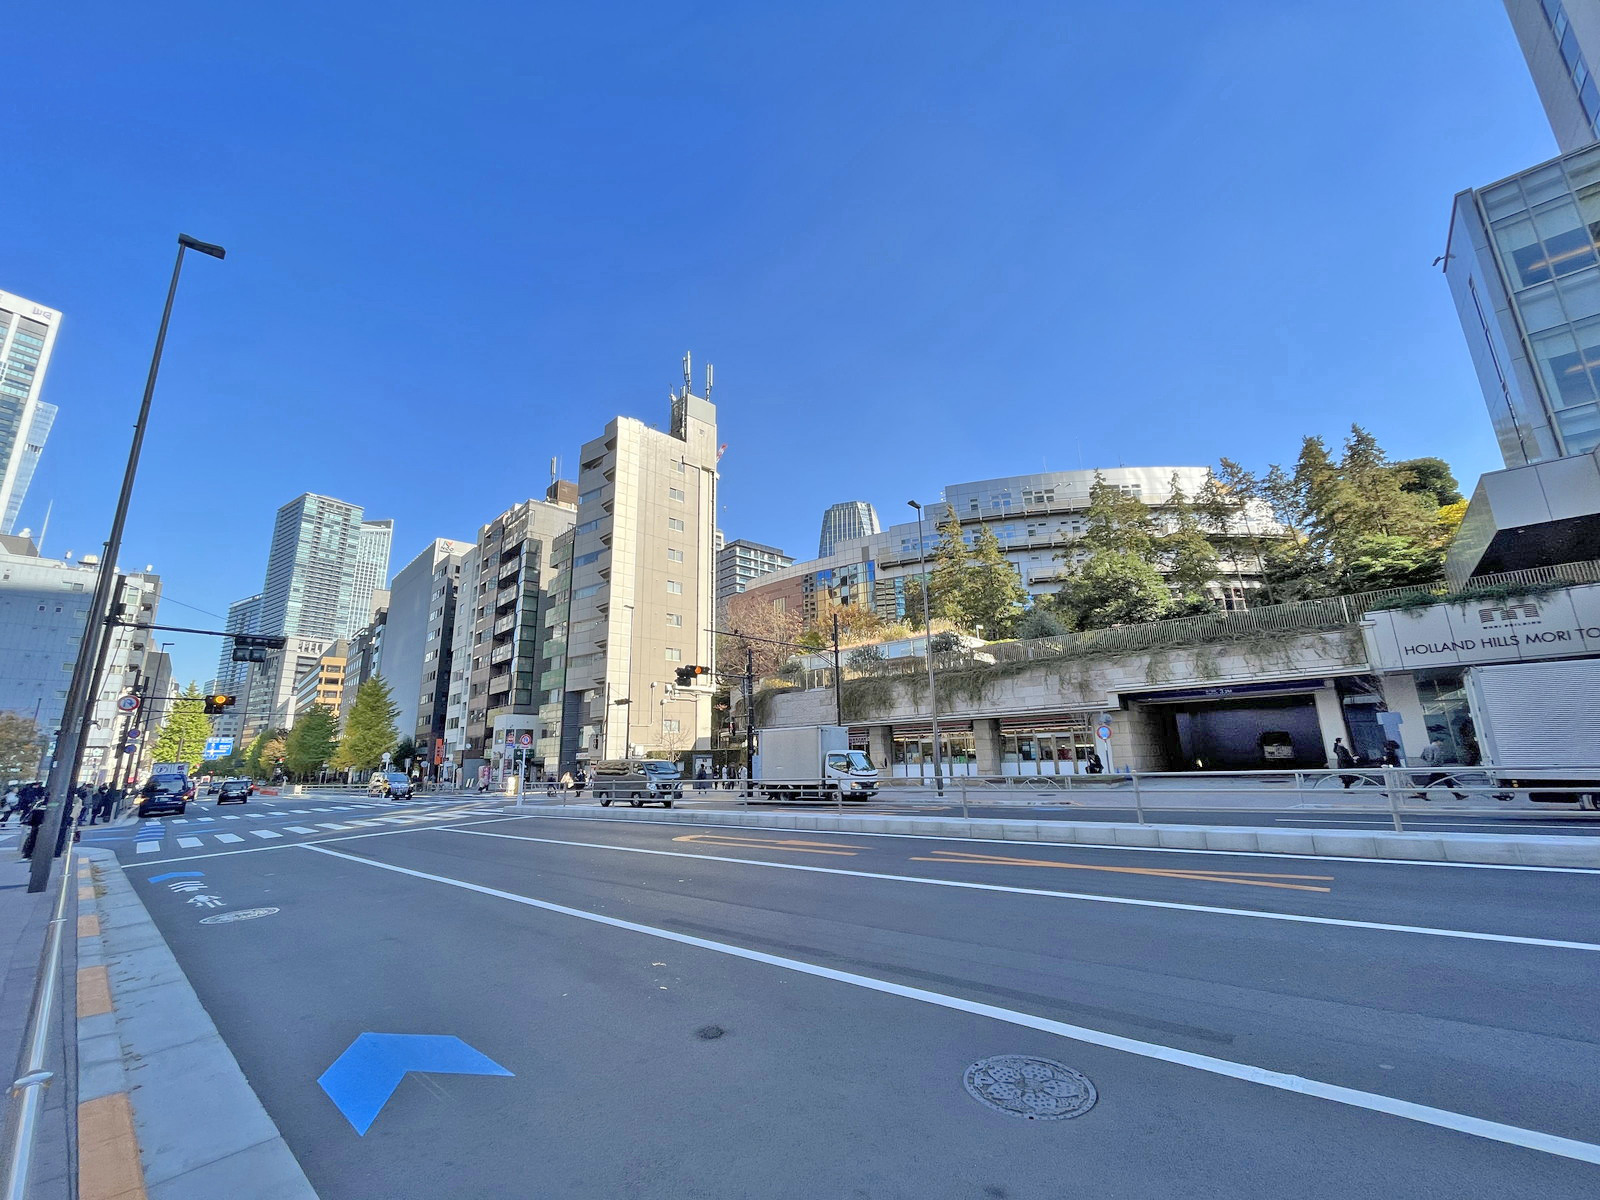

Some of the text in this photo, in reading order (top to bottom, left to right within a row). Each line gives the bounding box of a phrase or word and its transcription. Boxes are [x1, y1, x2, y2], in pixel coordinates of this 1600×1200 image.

[1404, 627, 1600, 656] HOLLAND HILLS MORI TO
